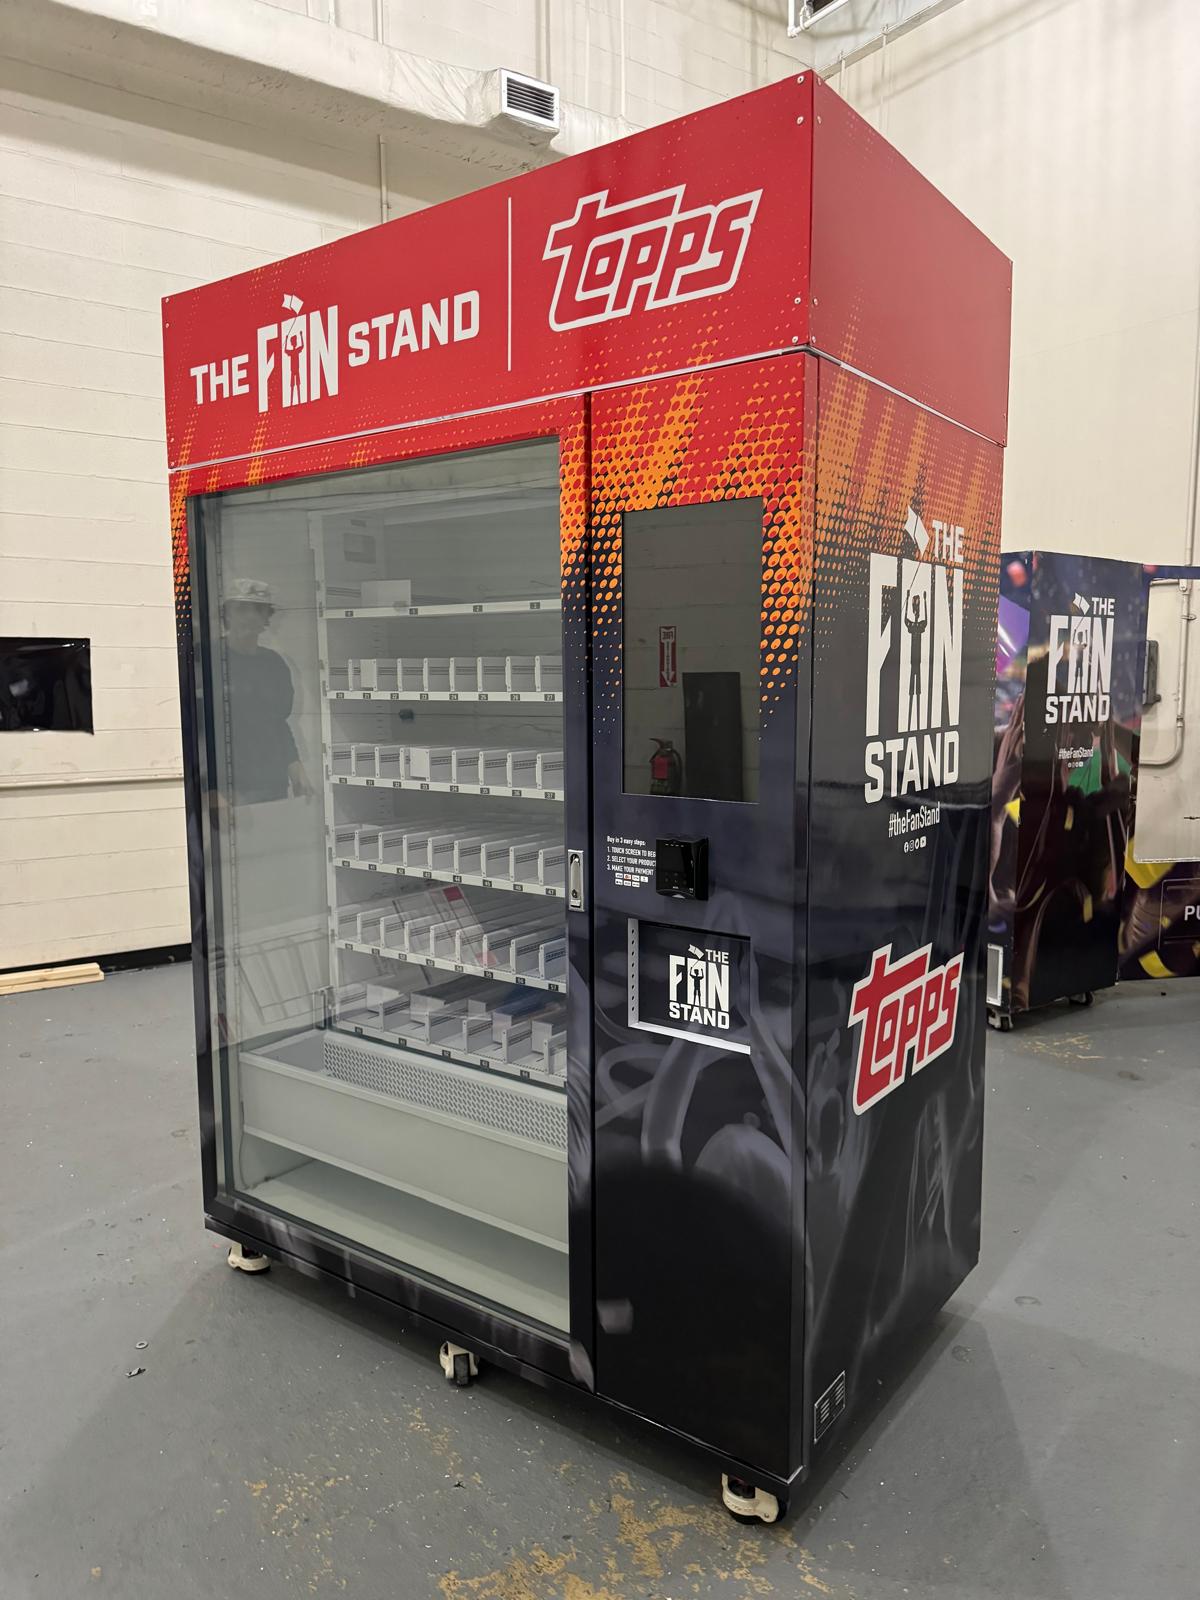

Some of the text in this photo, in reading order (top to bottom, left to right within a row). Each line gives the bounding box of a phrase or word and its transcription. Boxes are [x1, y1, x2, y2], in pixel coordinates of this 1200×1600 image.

[190, 353, 250, 406] THE
[348, 290, 480, 368] STAND
[932, 519, 965, 564] THE
[1091, 597, 1116, 616] THE
[1045, 694, 1111, 724] STAND
[864, 730, 960, 804] STAND
[888, 801, 940, 838] #theFanStand
[625, 848, 641, 856] SCREEN
[635, 867, 654, 876] PAYMENT
[705, 948, 730, 964] THE
[669, 1002, 730, 1030] STAND
